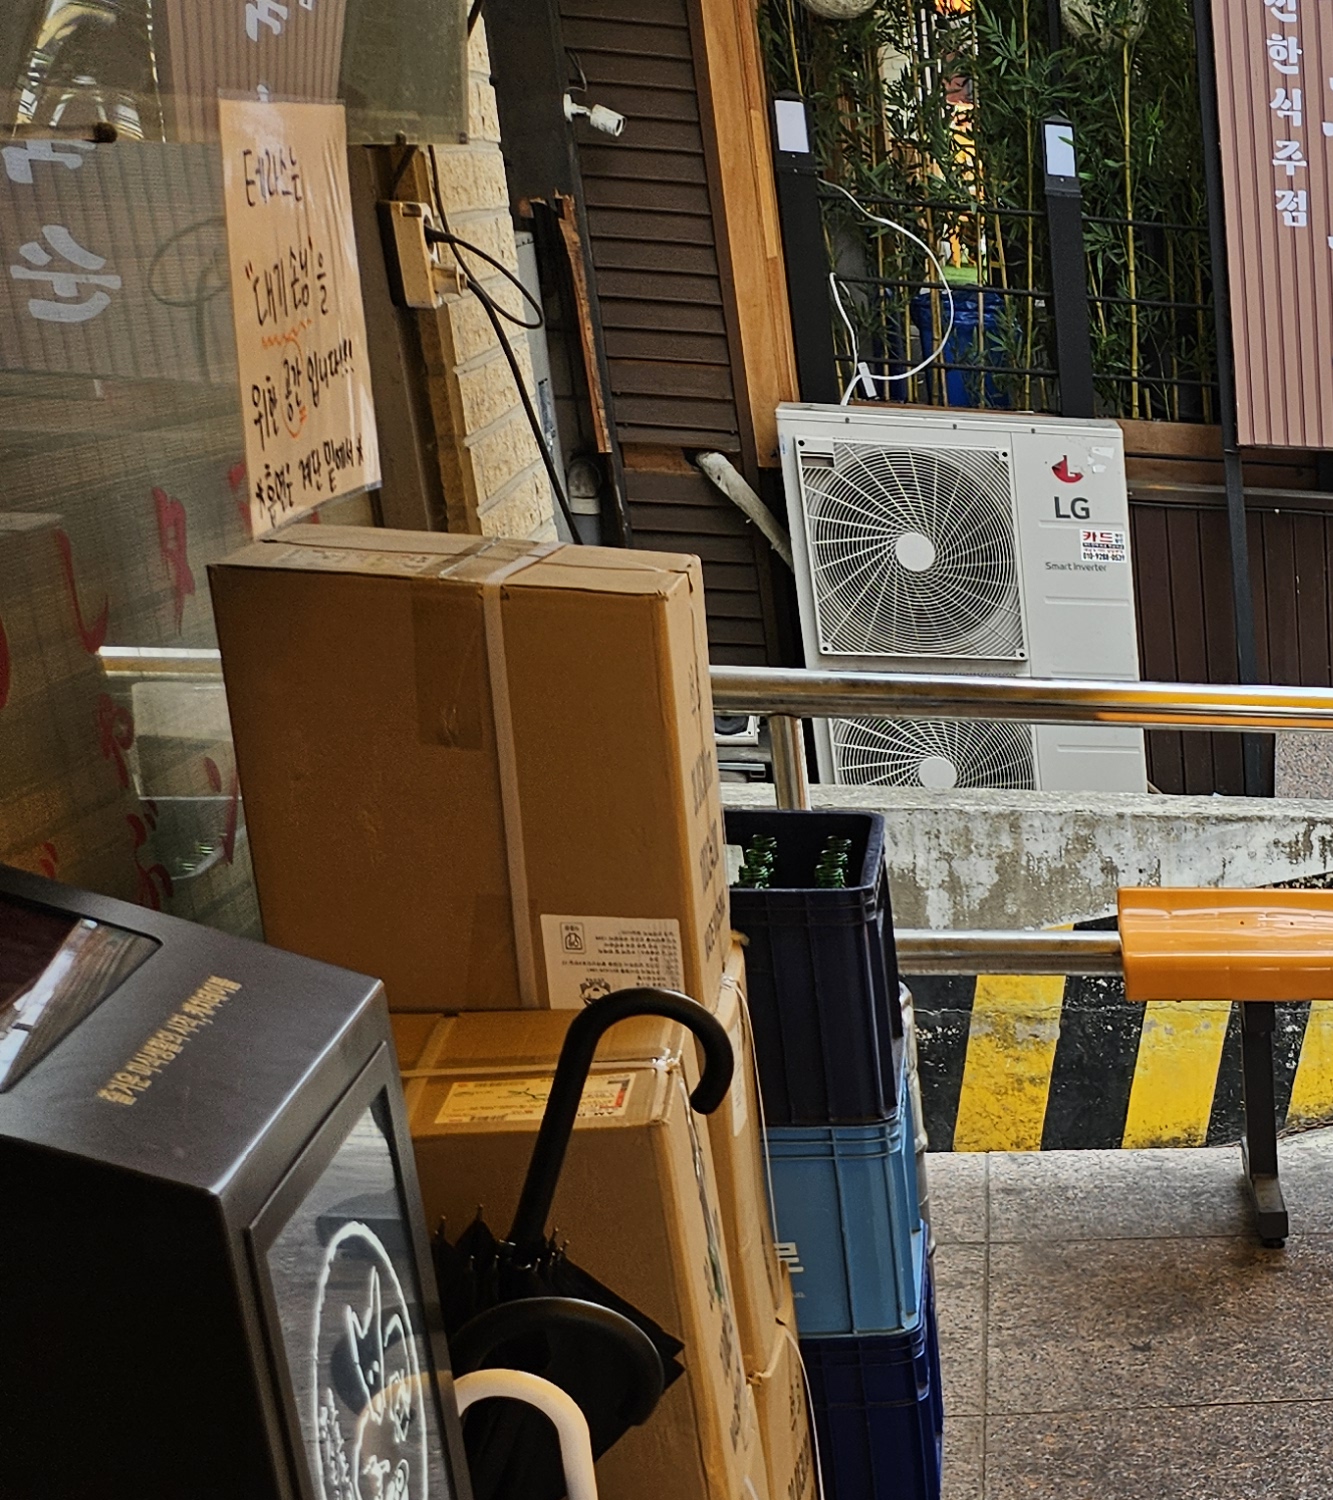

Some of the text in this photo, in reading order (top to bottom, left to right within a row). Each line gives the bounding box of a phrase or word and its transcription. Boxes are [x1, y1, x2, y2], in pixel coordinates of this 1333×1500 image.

[243, 146, 302, 207] 테라스는
[251, 375, 279, 451] 위한
[282, 356, 303, 422] 공간
[1054, 496, 1091, 519] LG
[1083, 531, 1113, 543] 카드
[1045, 561, 1107, 573] Smart Inverter
